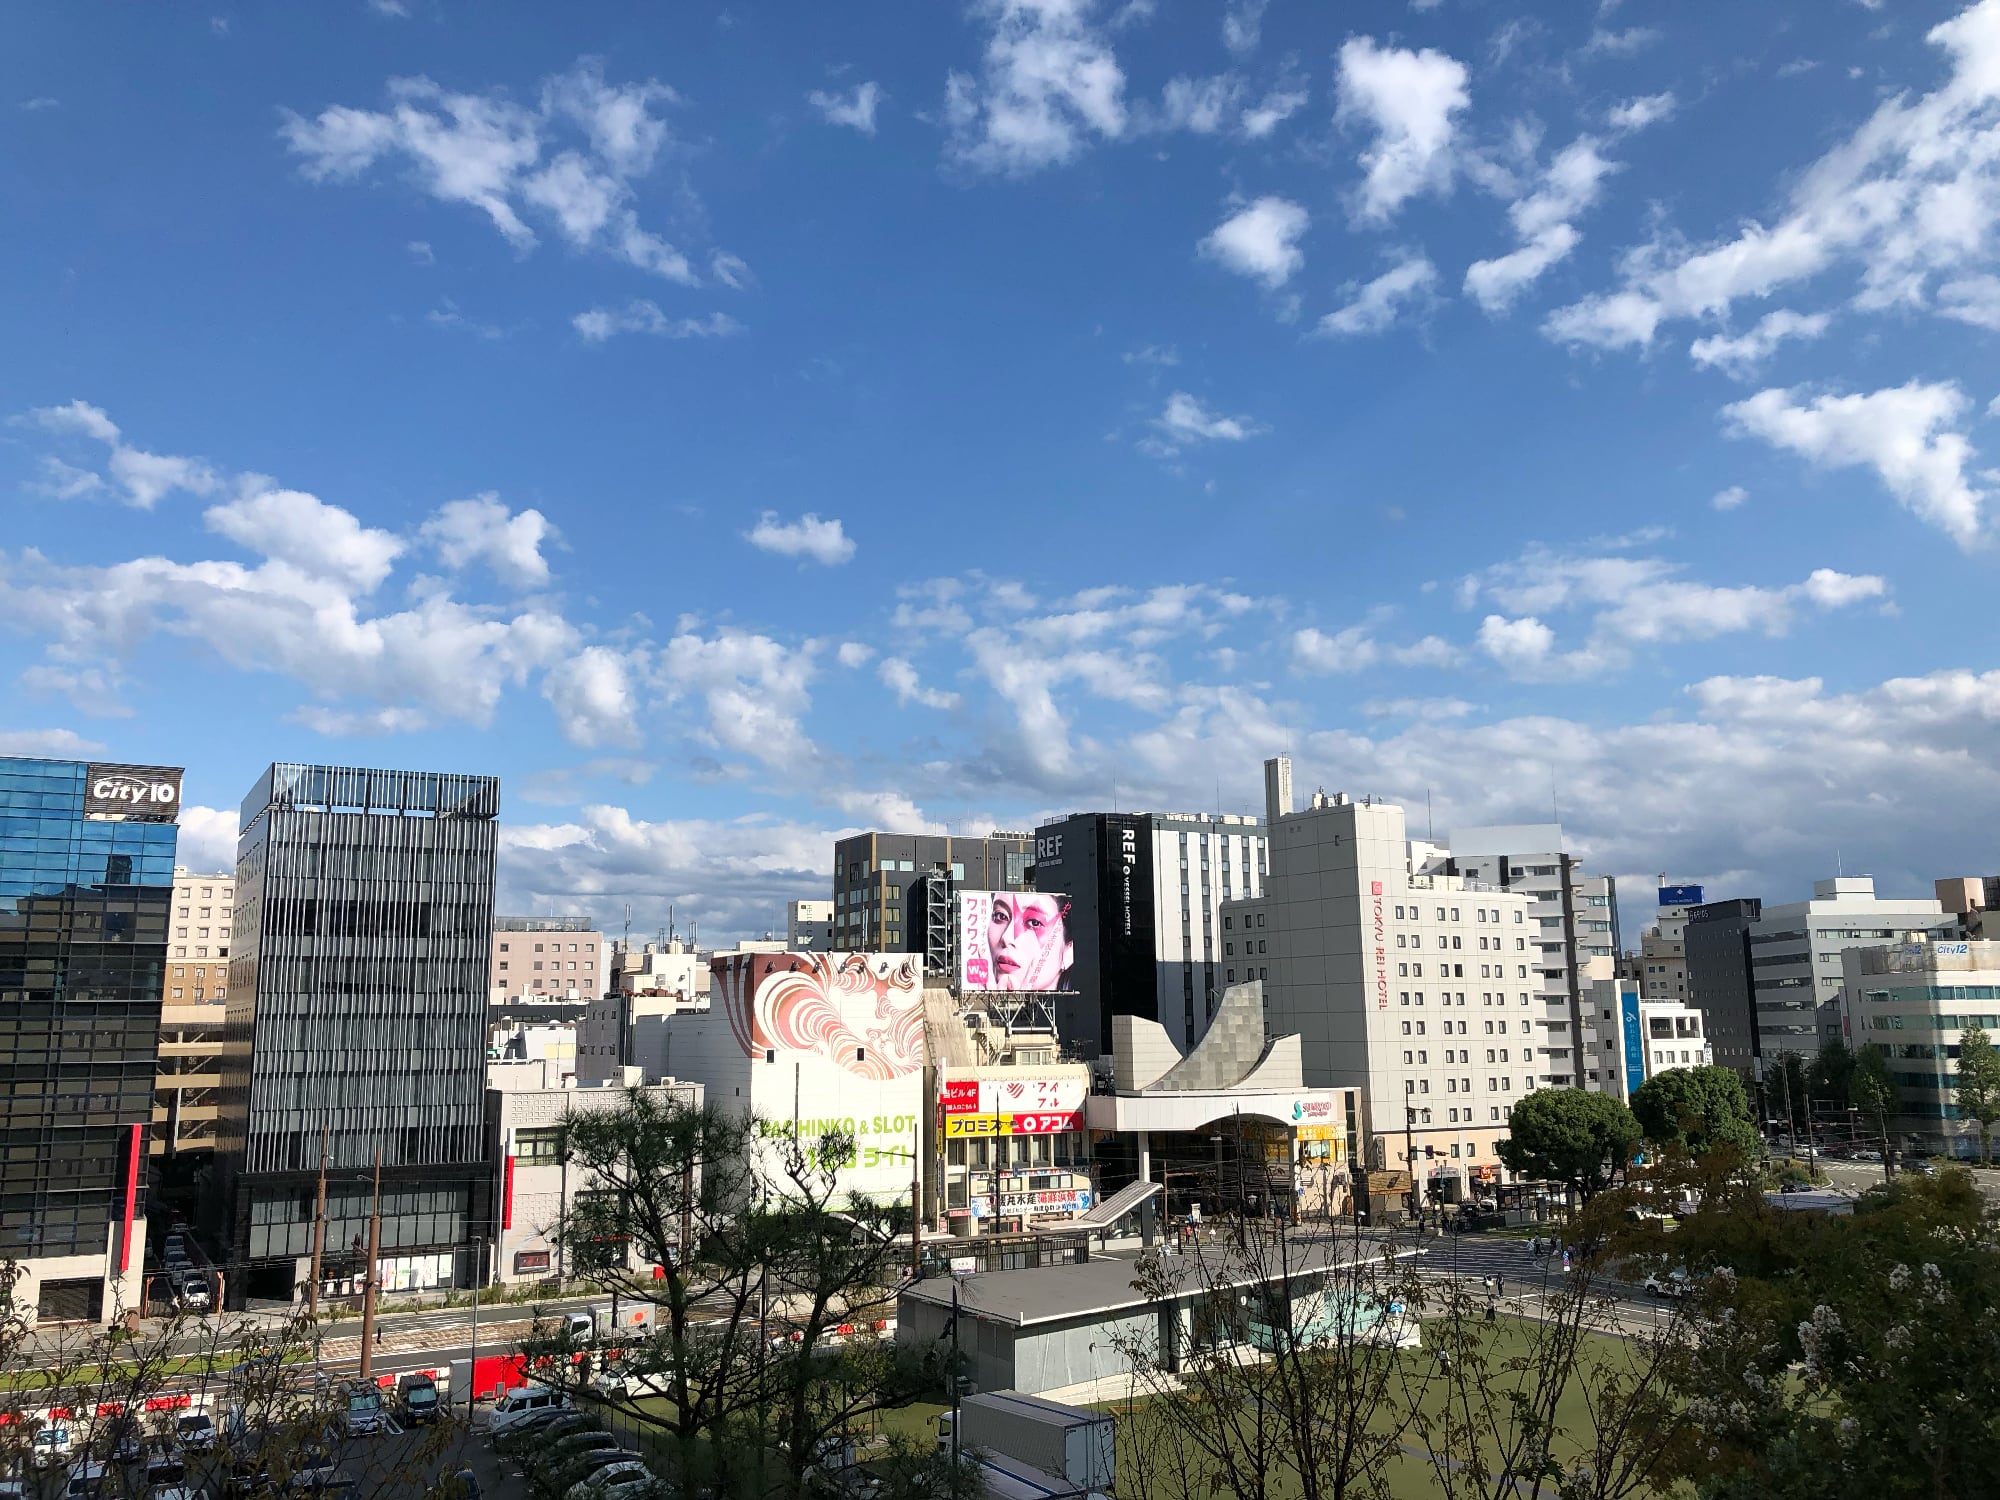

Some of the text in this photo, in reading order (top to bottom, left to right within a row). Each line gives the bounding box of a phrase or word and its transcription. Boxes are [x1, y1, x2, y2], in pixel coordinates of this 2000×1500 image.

[1037, 834, 1064, 859] REF
[1122, 829, 1135, 864] REF
[966, 898, 979, 956] ワクワク
[1373, 897, 1388, 1011] TOKYU REI HOTEL
[1937, 943, 1968, 954] City12
[859, 1120, 869, 1134] &
[873, 1115, 916, 1134] SLOT
[951, 1118, 1002, 1133] プロミス
[1039, 1116, 1074, 1130] アコム
